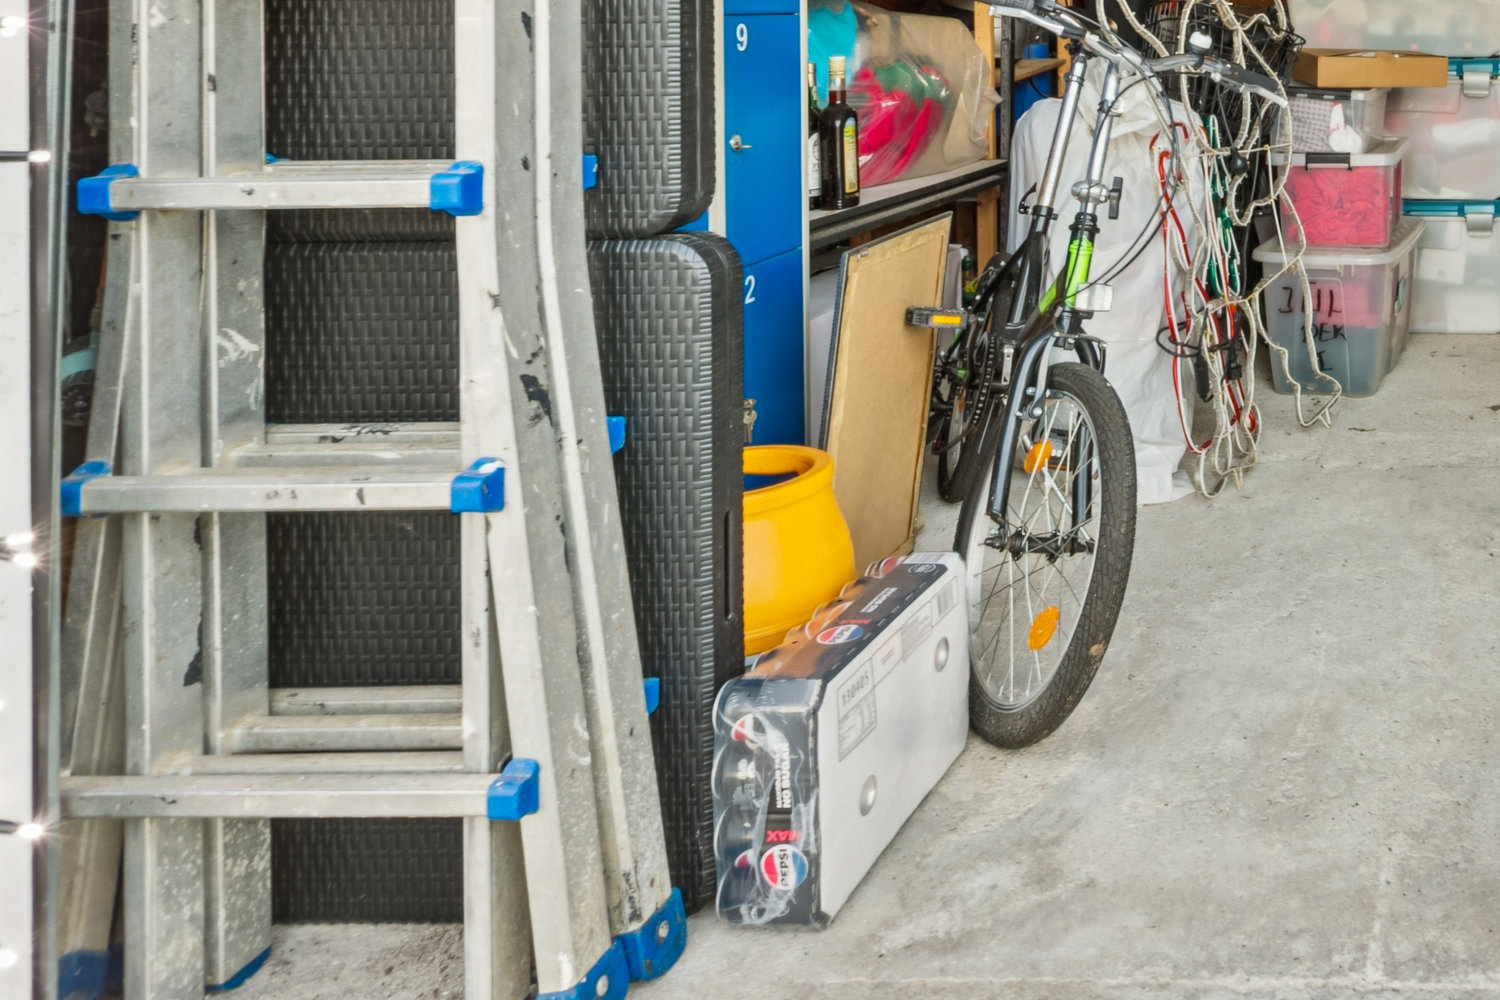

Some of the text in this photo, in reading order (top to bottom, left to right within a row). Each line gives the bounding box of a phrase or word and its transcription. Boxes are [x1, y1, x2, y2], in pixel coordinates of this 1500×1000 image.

[736, 23, 748, 51] 9
[782, 789, 792, 809] NO
[778, 848, 790, 888] PEPSI
